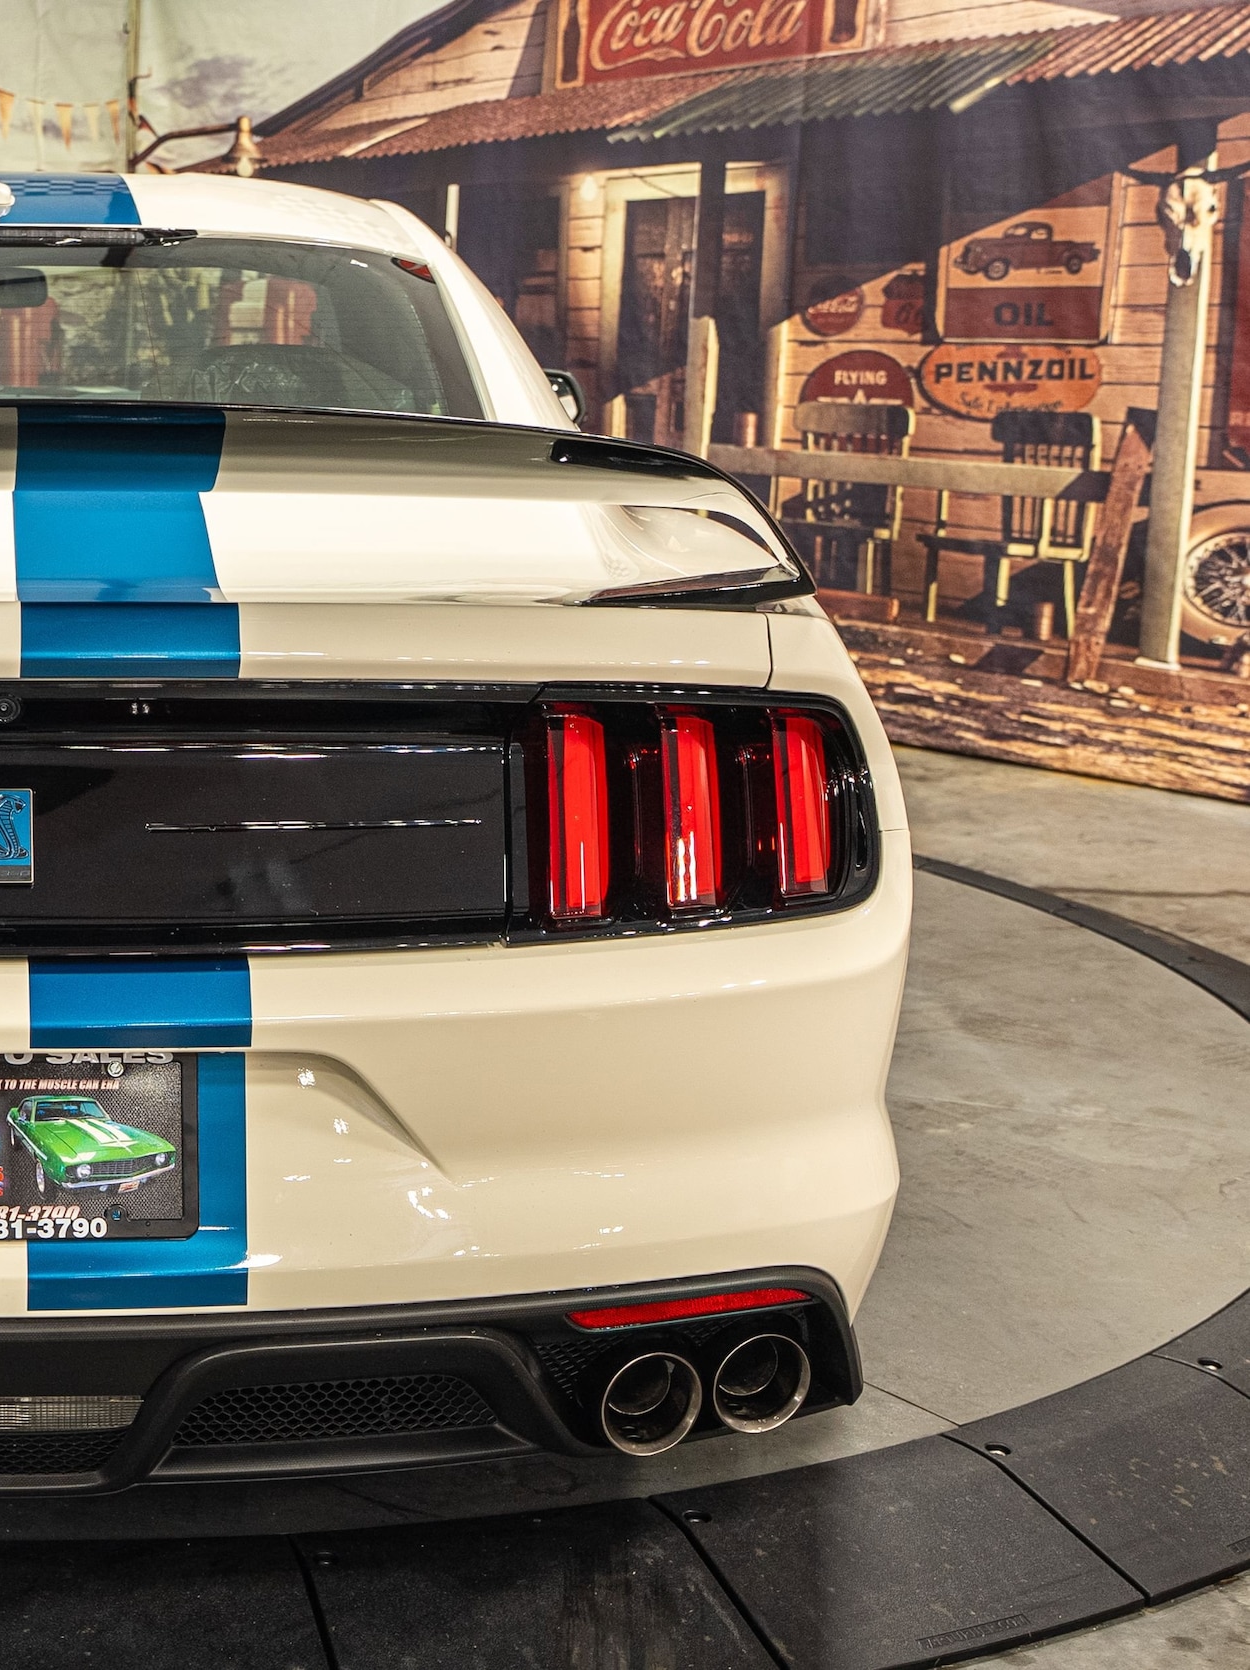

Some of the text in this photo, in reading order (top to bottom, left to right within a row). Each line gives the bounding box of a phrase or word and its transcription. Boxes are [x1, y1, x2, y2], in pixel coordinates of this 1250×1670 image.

[994, 302, 1055, 327] OIL
[834, 370, 888, 386] FLYING
[934, 357, 1096, 385] PENNZOIL
[4, 1079, 18, 1091] TO
[18, 1079, 38, 1091] THE
[38, 1079, 78, 1091] MUSCLE
[78, 1079, 100, 1091] CAR
[100, 1079, 120, 1091] ERA
